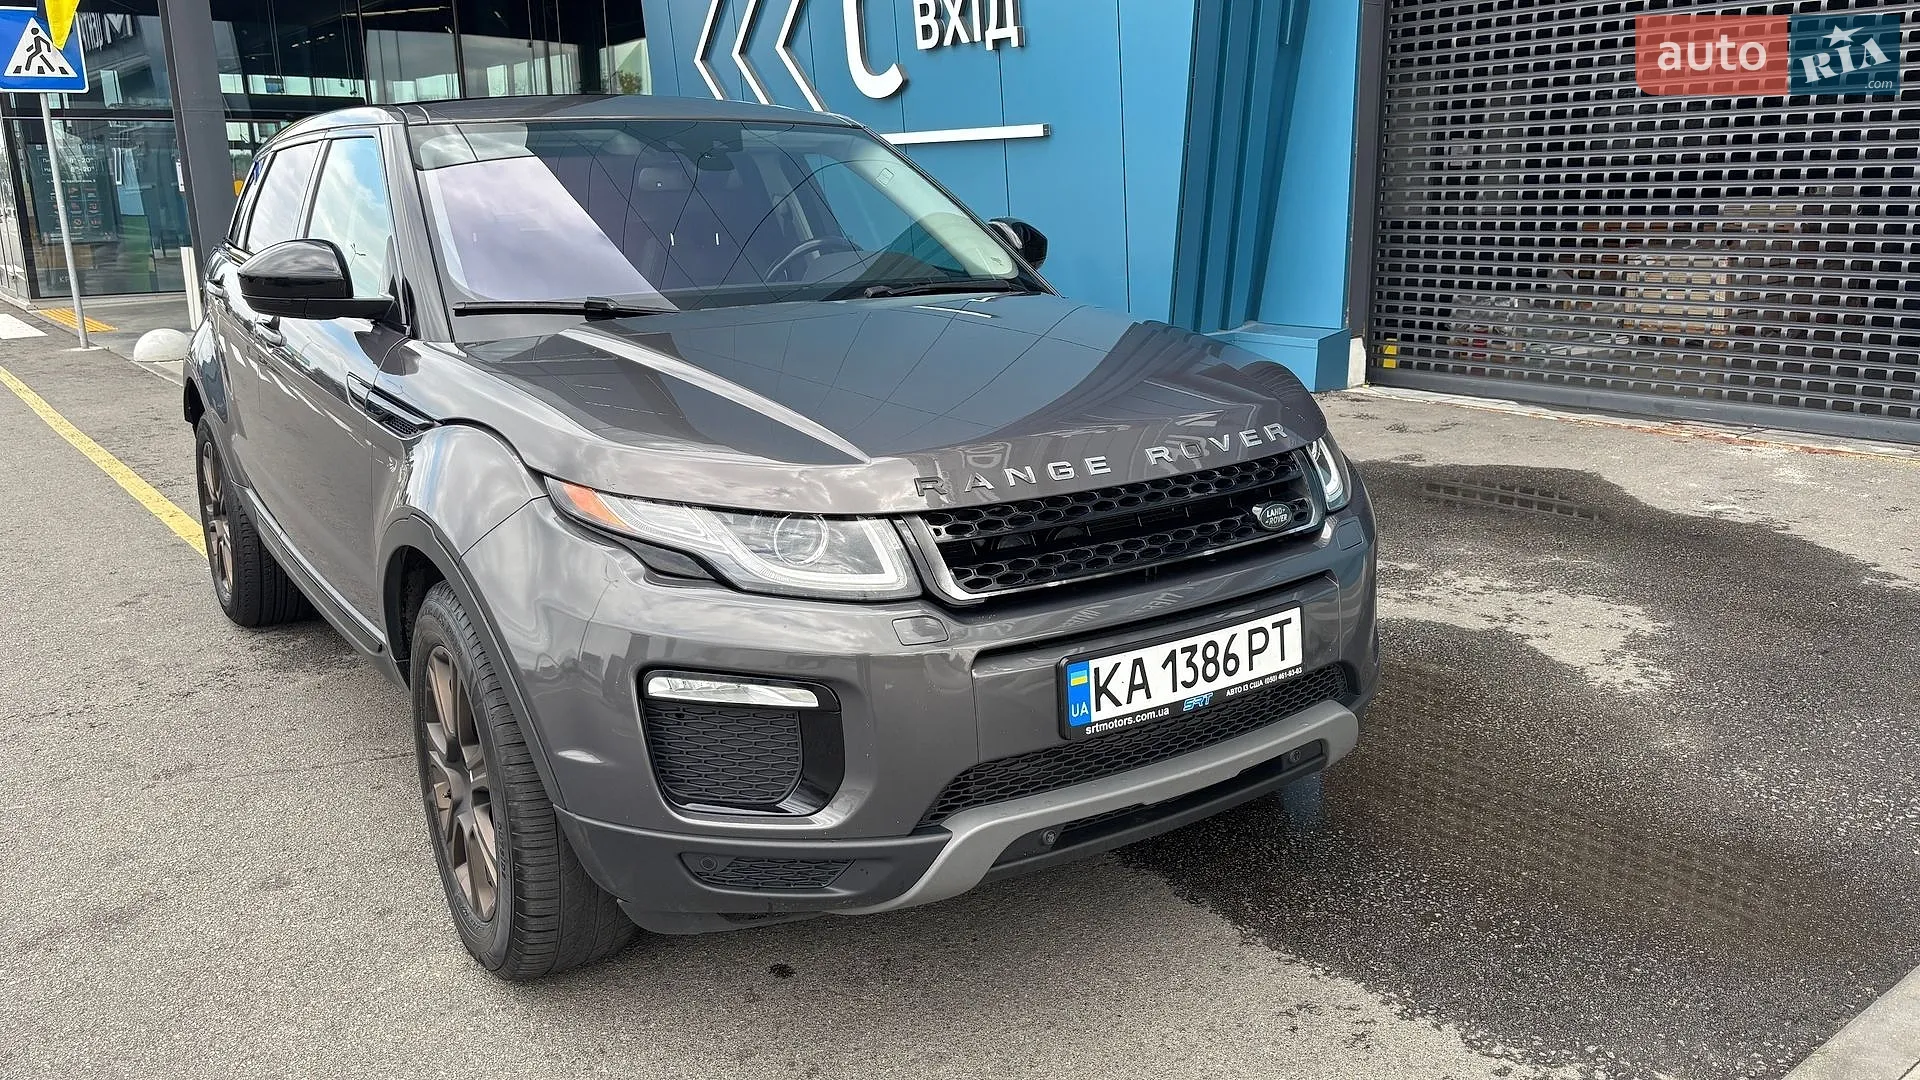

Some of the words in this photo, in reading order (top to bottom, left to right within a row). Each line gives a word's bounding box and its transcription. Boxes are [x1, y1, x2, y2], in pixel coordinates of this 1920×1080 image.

[913, 456, 1111, 497] RANGE
[1145, 422, 1289, 465] ROVER
[1266, 507, 1283, 518] LAND
[1268, 513, 1288, 526] ROVER
[1161, 633, 1240, 693] 1386
[1226, 687, 1242, 696] АВТО
[1249, 680, 1263, 689] США
[1071, 702, 1089, 718] UA
[1183, 692, 1214, 711] SRT
[1085, 706, 1170, 735] srtmotors.com.ua
